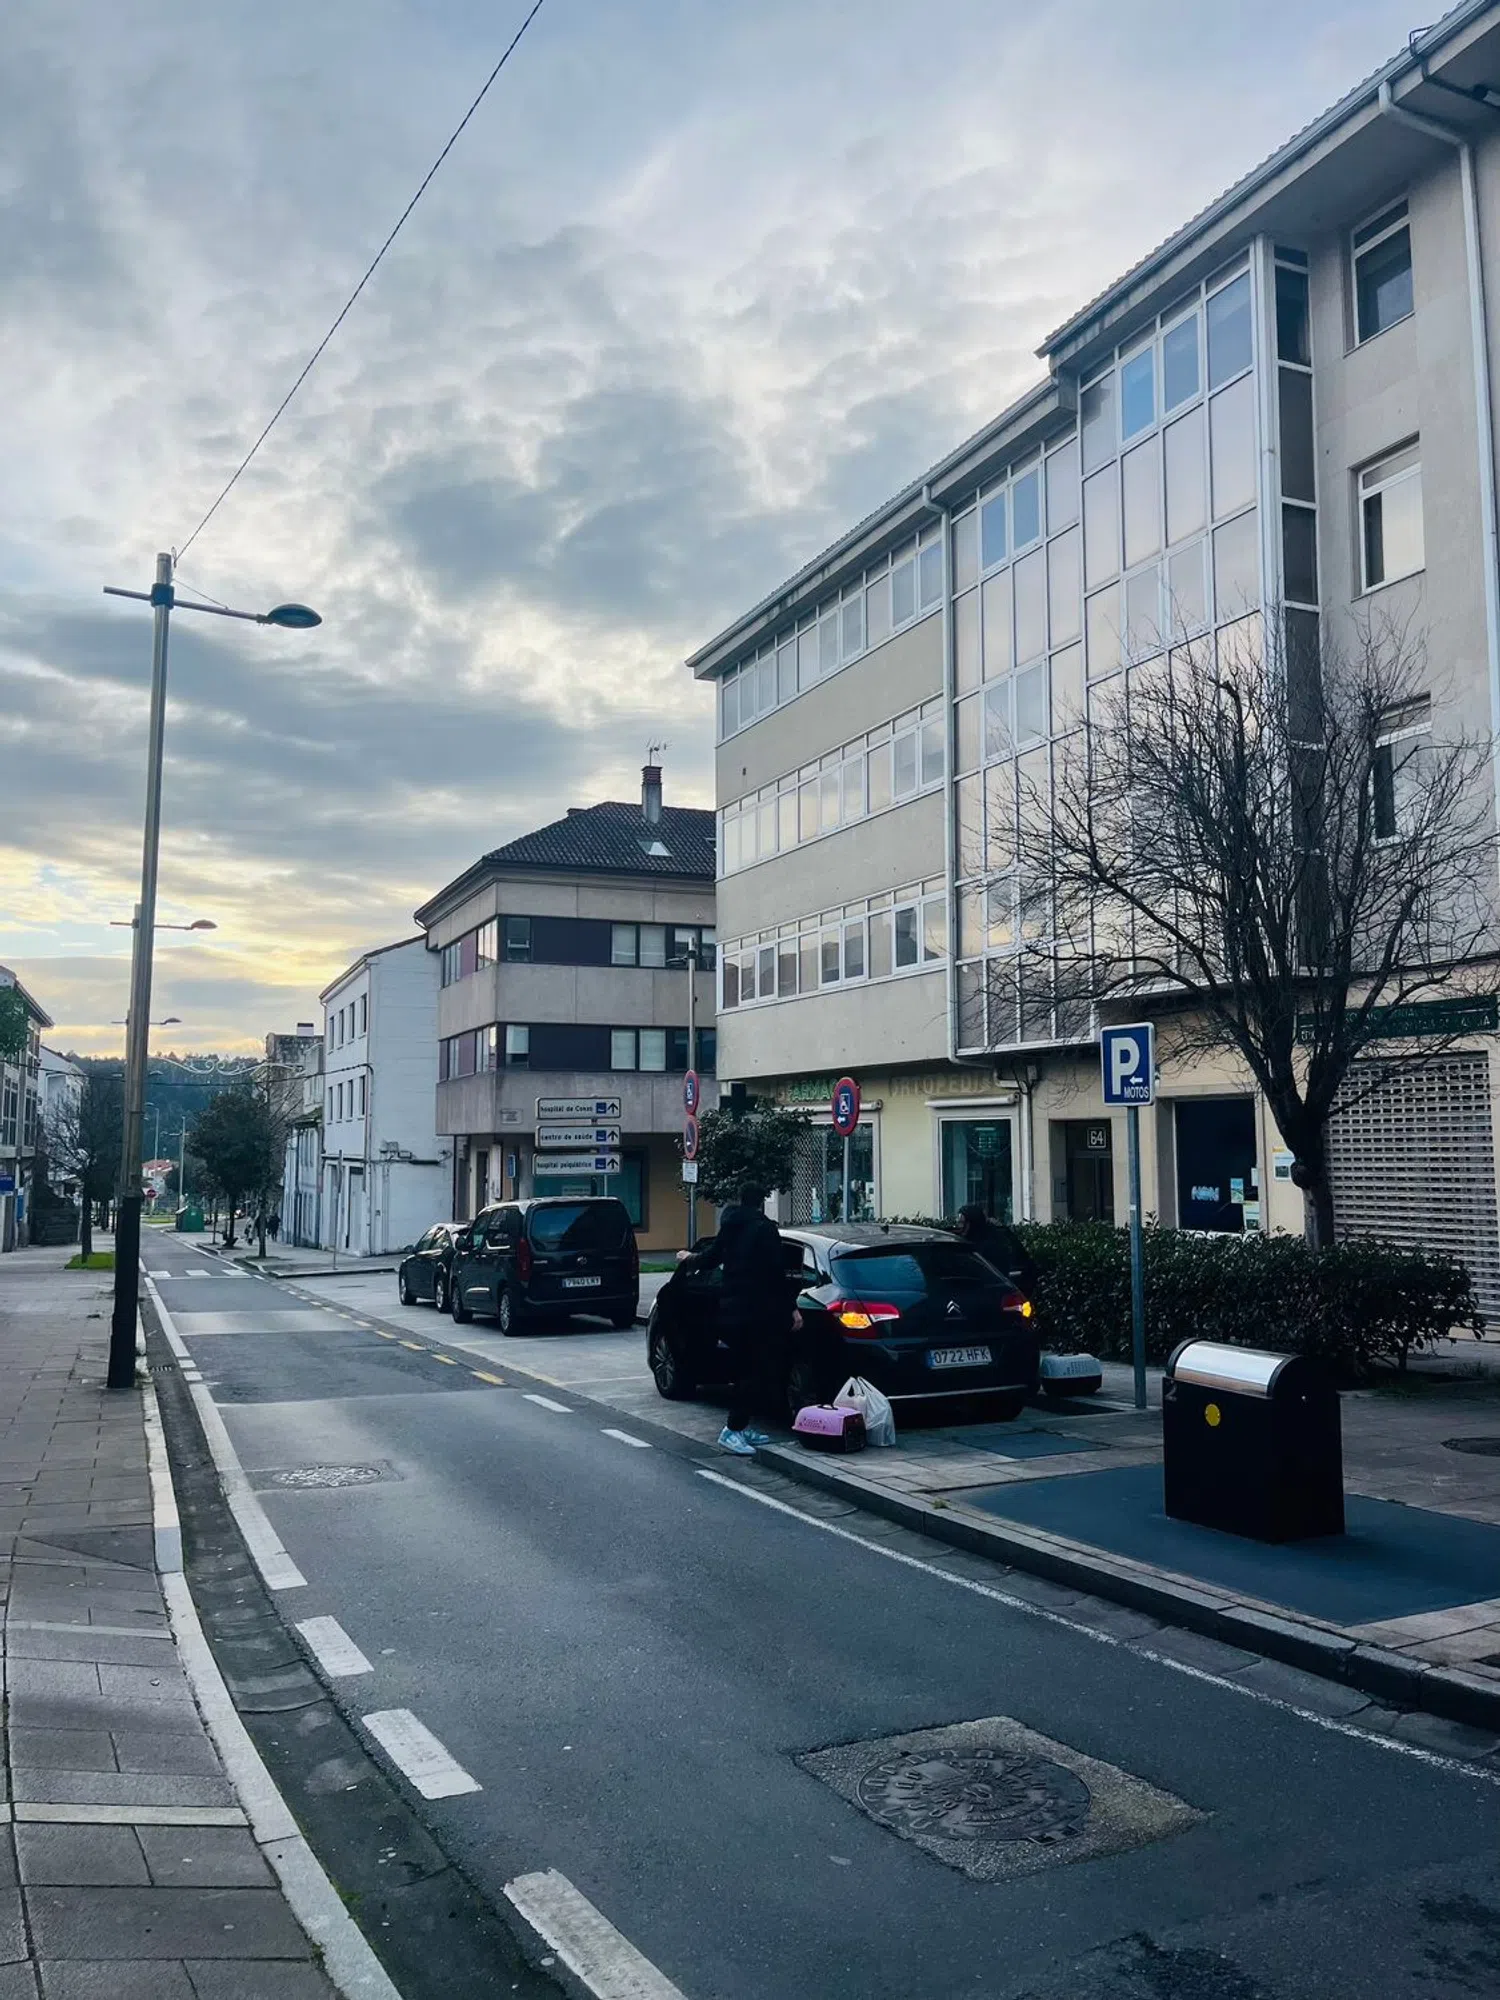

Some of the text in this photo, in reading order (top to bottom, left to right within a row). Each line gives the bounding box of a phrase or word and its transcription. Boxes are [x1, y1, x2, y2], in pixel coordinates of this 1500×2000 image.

[1111, 1037, 1140, 1095] P
[1124, 1086, 1149, 1099] MOTOS
[540, 1105, 564, 1113] hospital
[564, 1132, 572, 1140] de
[1090, 1130, 1104, 1145] 64
[537, 1161, 559, 1169] hospital
[934, 1348, 989, 1364] 0722 HFK
